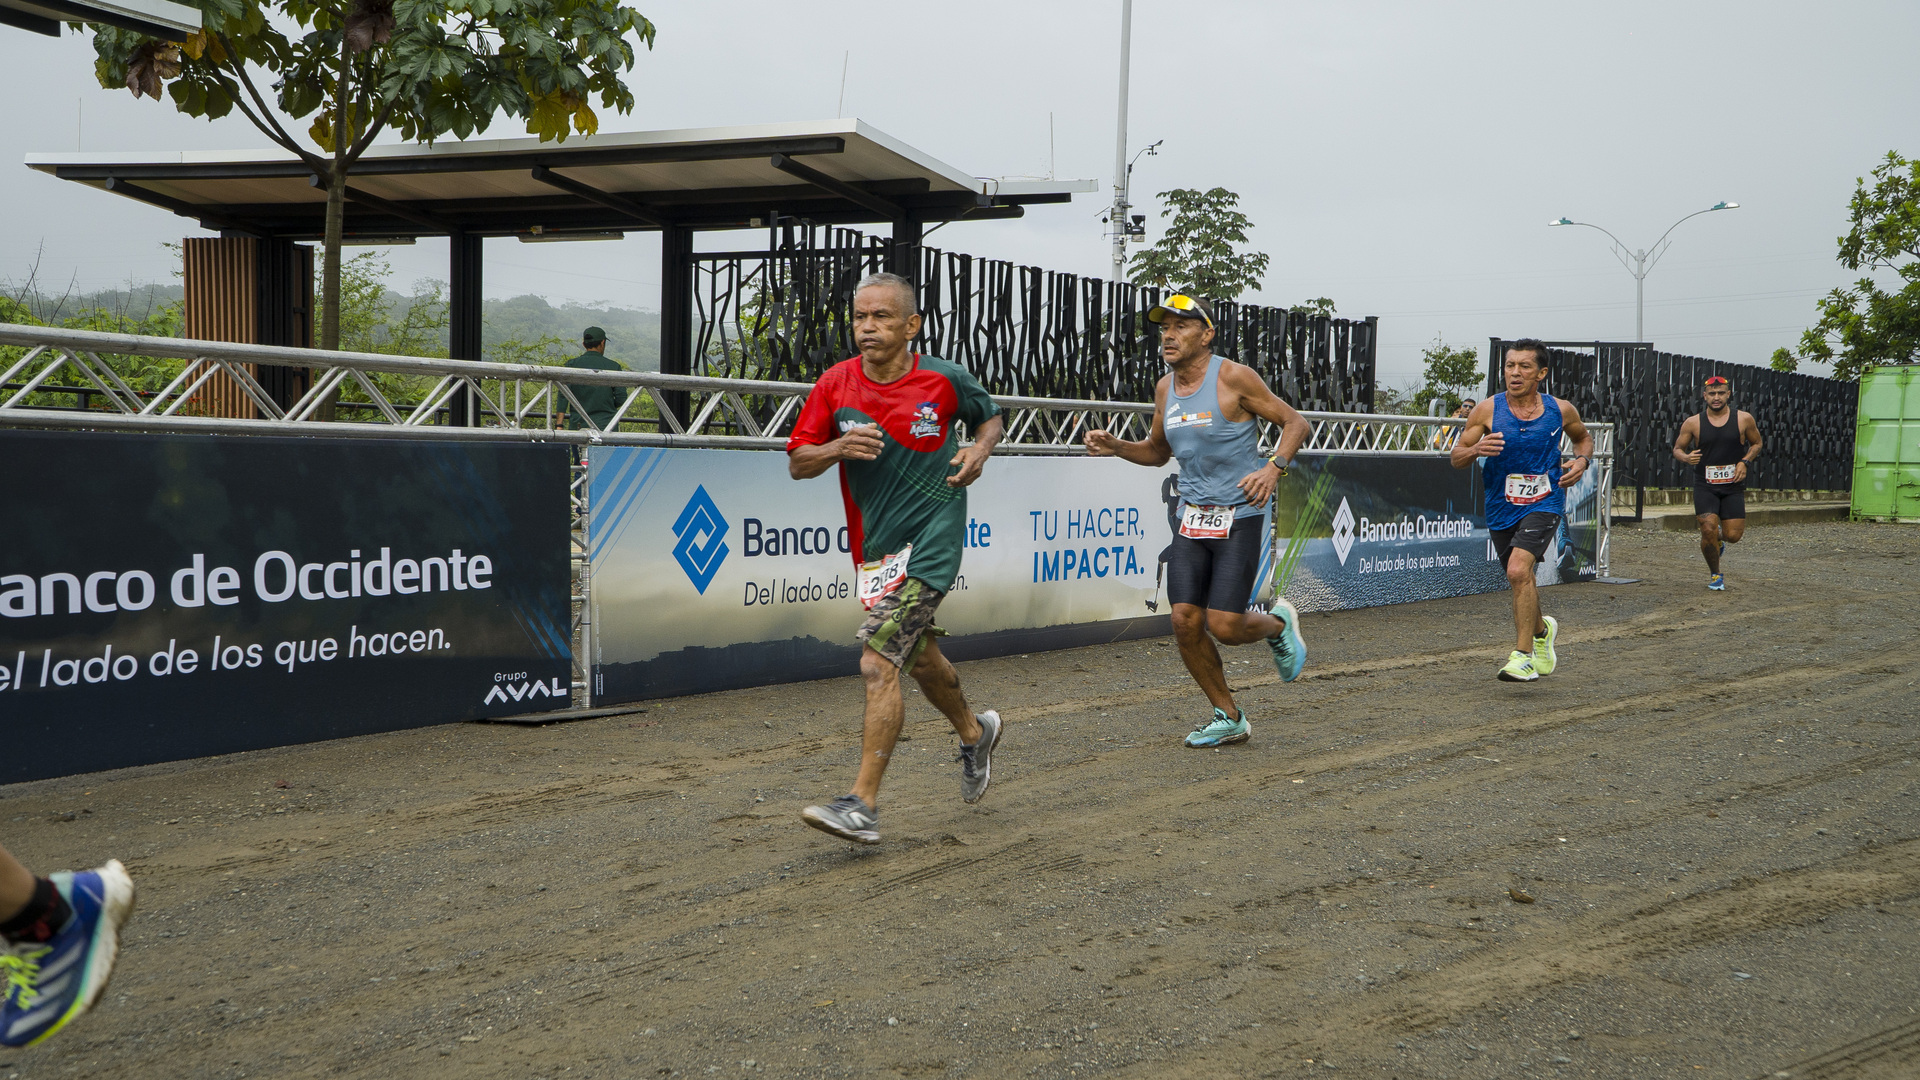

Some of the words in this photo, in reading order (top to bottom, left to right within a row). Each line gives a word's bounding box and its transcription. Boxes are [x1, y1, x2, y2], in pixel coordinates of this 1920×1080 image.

[1518, 483, 1539, 496] 726
[1713, 471, 1730, 479] 516
[1030, 510, 1058, 541] TU
[1068, 507, 1145, 540] HACER,
[1190, 513, 1223, 528] 1146
[1359, 517, 1398, 543] Banco
[1399, 515, 1415, 540] de
[1416, 514, 1472, 540] Occidente
[743, 518, 831, 557] Banco
[1033, 545, 1145, 583] IMPACTA.
[1359, 556, 1374, 574] Del
[1374, 554, 1393, 572] lado
[1394, 553, 1405, 571] de
[1406, 553, 1418, 570] los
[1419, 555, 1434, 573] que
[1435, 551, 1461, 568] hacen.
[1578, 564, 1596, 576] AVAL
[0, 569, 156, 618] anco
[170, 553, 241, 608] de
[253, 546, 493, 603] Occidente
[743, 578, 776, 607] Del
[781, 576, 823, 604] lado
[827, 574, 849, 600] de
[39, 644, 138, 687] lado
[149, 638, 199, 677] de
[211, 635, 264, 671] los
[274, 637, 338, 674] que
[348, 624, 451, 659] hacen.
[483, 677, 567, 706] AVAL
[494, 671, 528, 683] Grupo
